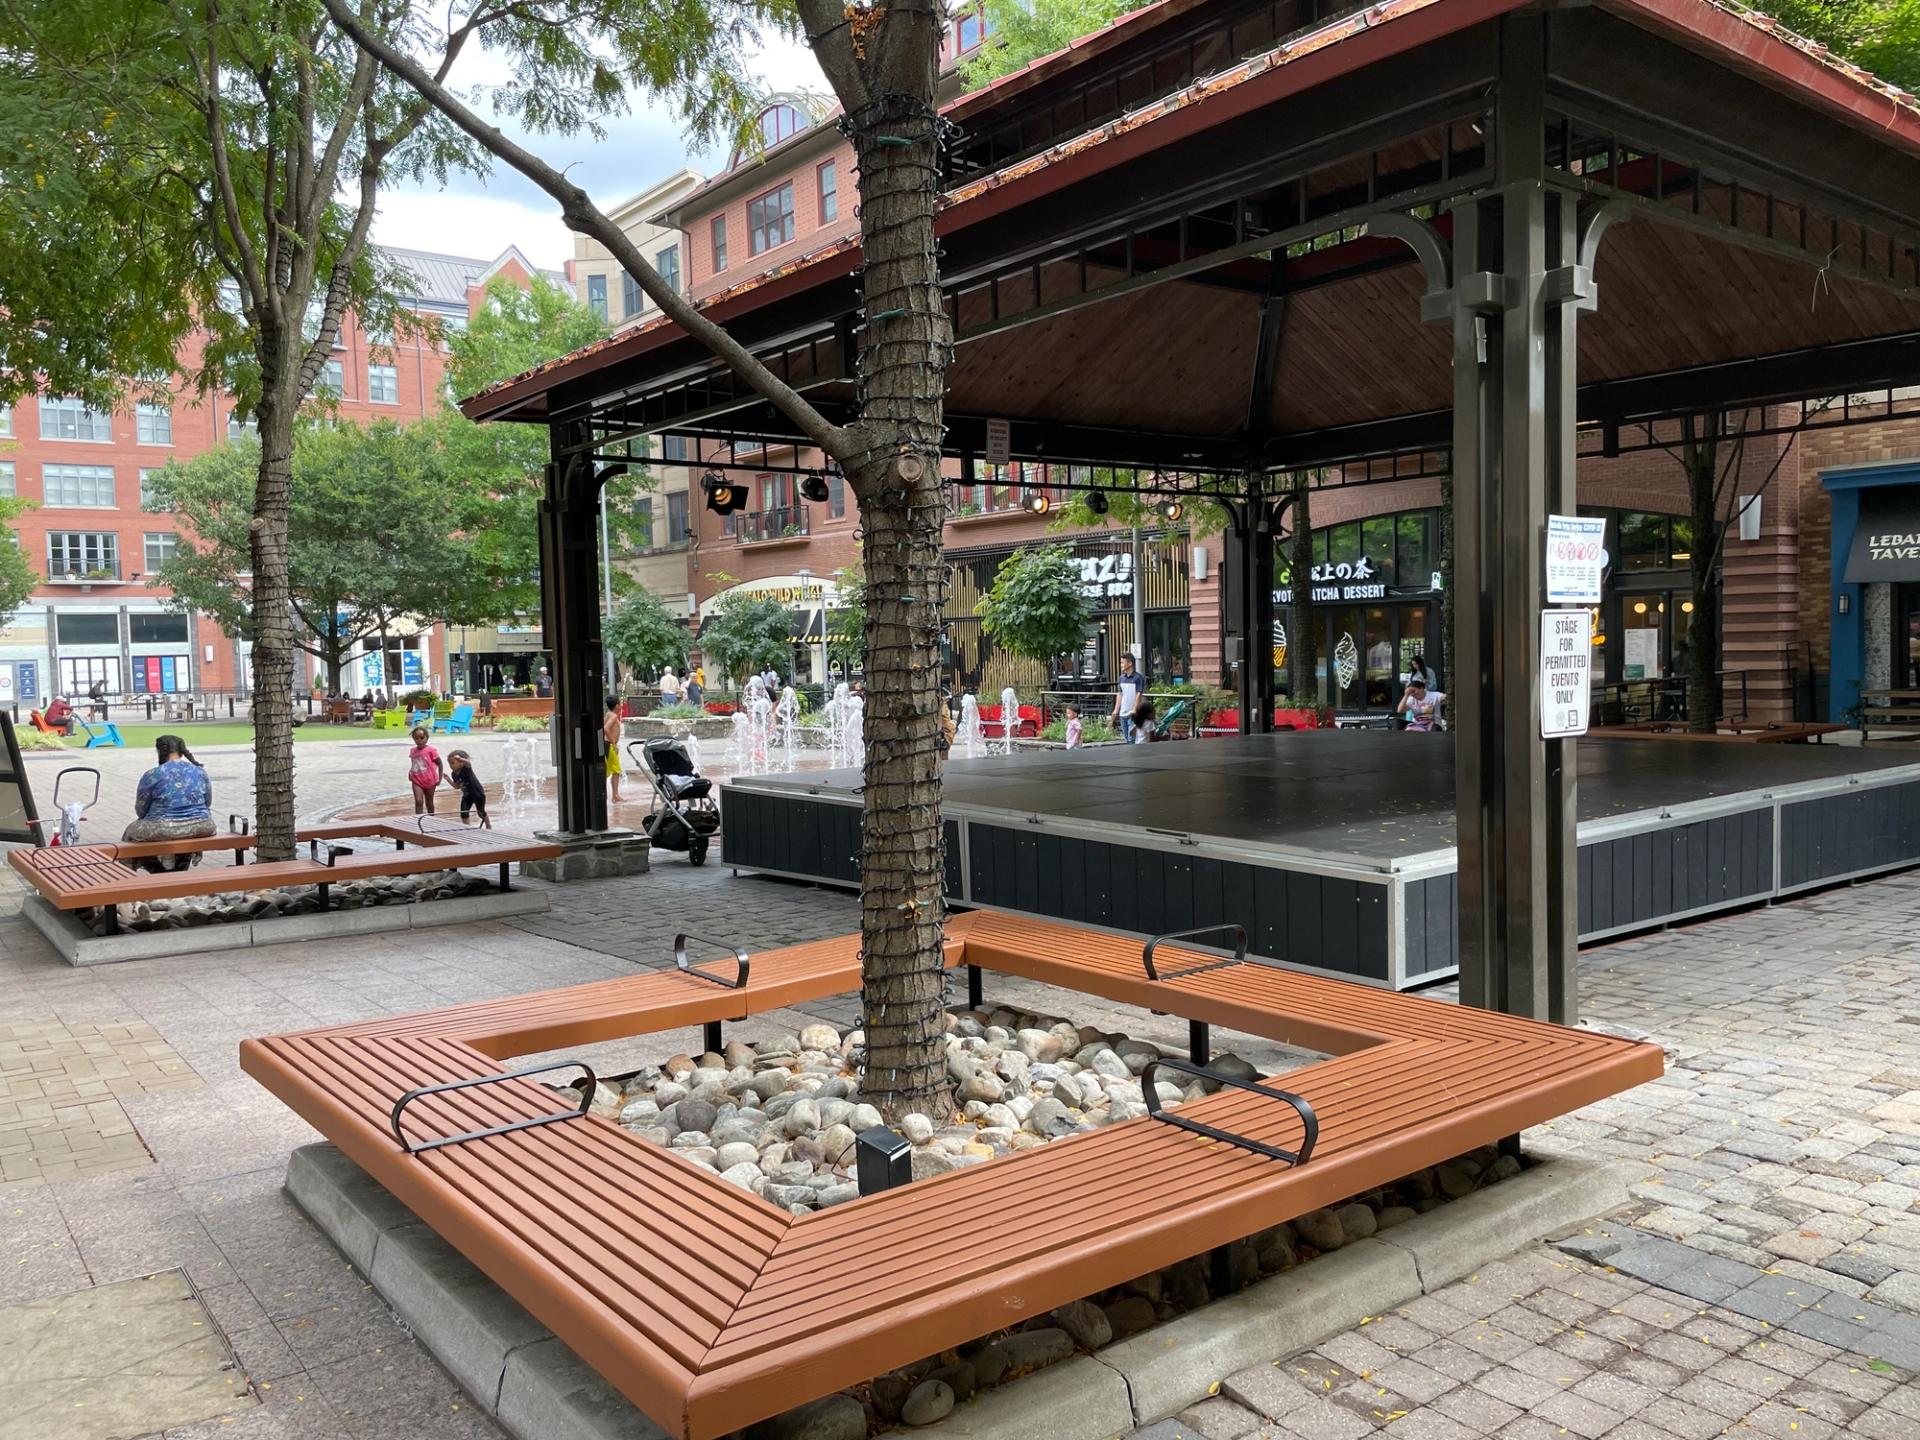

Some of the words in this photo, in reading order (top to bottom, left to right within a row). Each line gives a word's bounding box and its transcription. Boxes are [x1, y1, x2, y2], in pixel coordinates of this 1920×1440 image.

[1869, 547, 1920, 561] TAVE
[1312, 587, 1340, 601] ATCHA
[1344, 584, 1385, 600] DESSERT
[1555, 620, 1579, 634] STAGE
[1559, 638, 1574, 652] FOR
[1545, 655, 1587, 670] PERMITTED
[1551, 672, 1580, 687] EVENTS
[1556, 690, 1574, 705] ONLY
